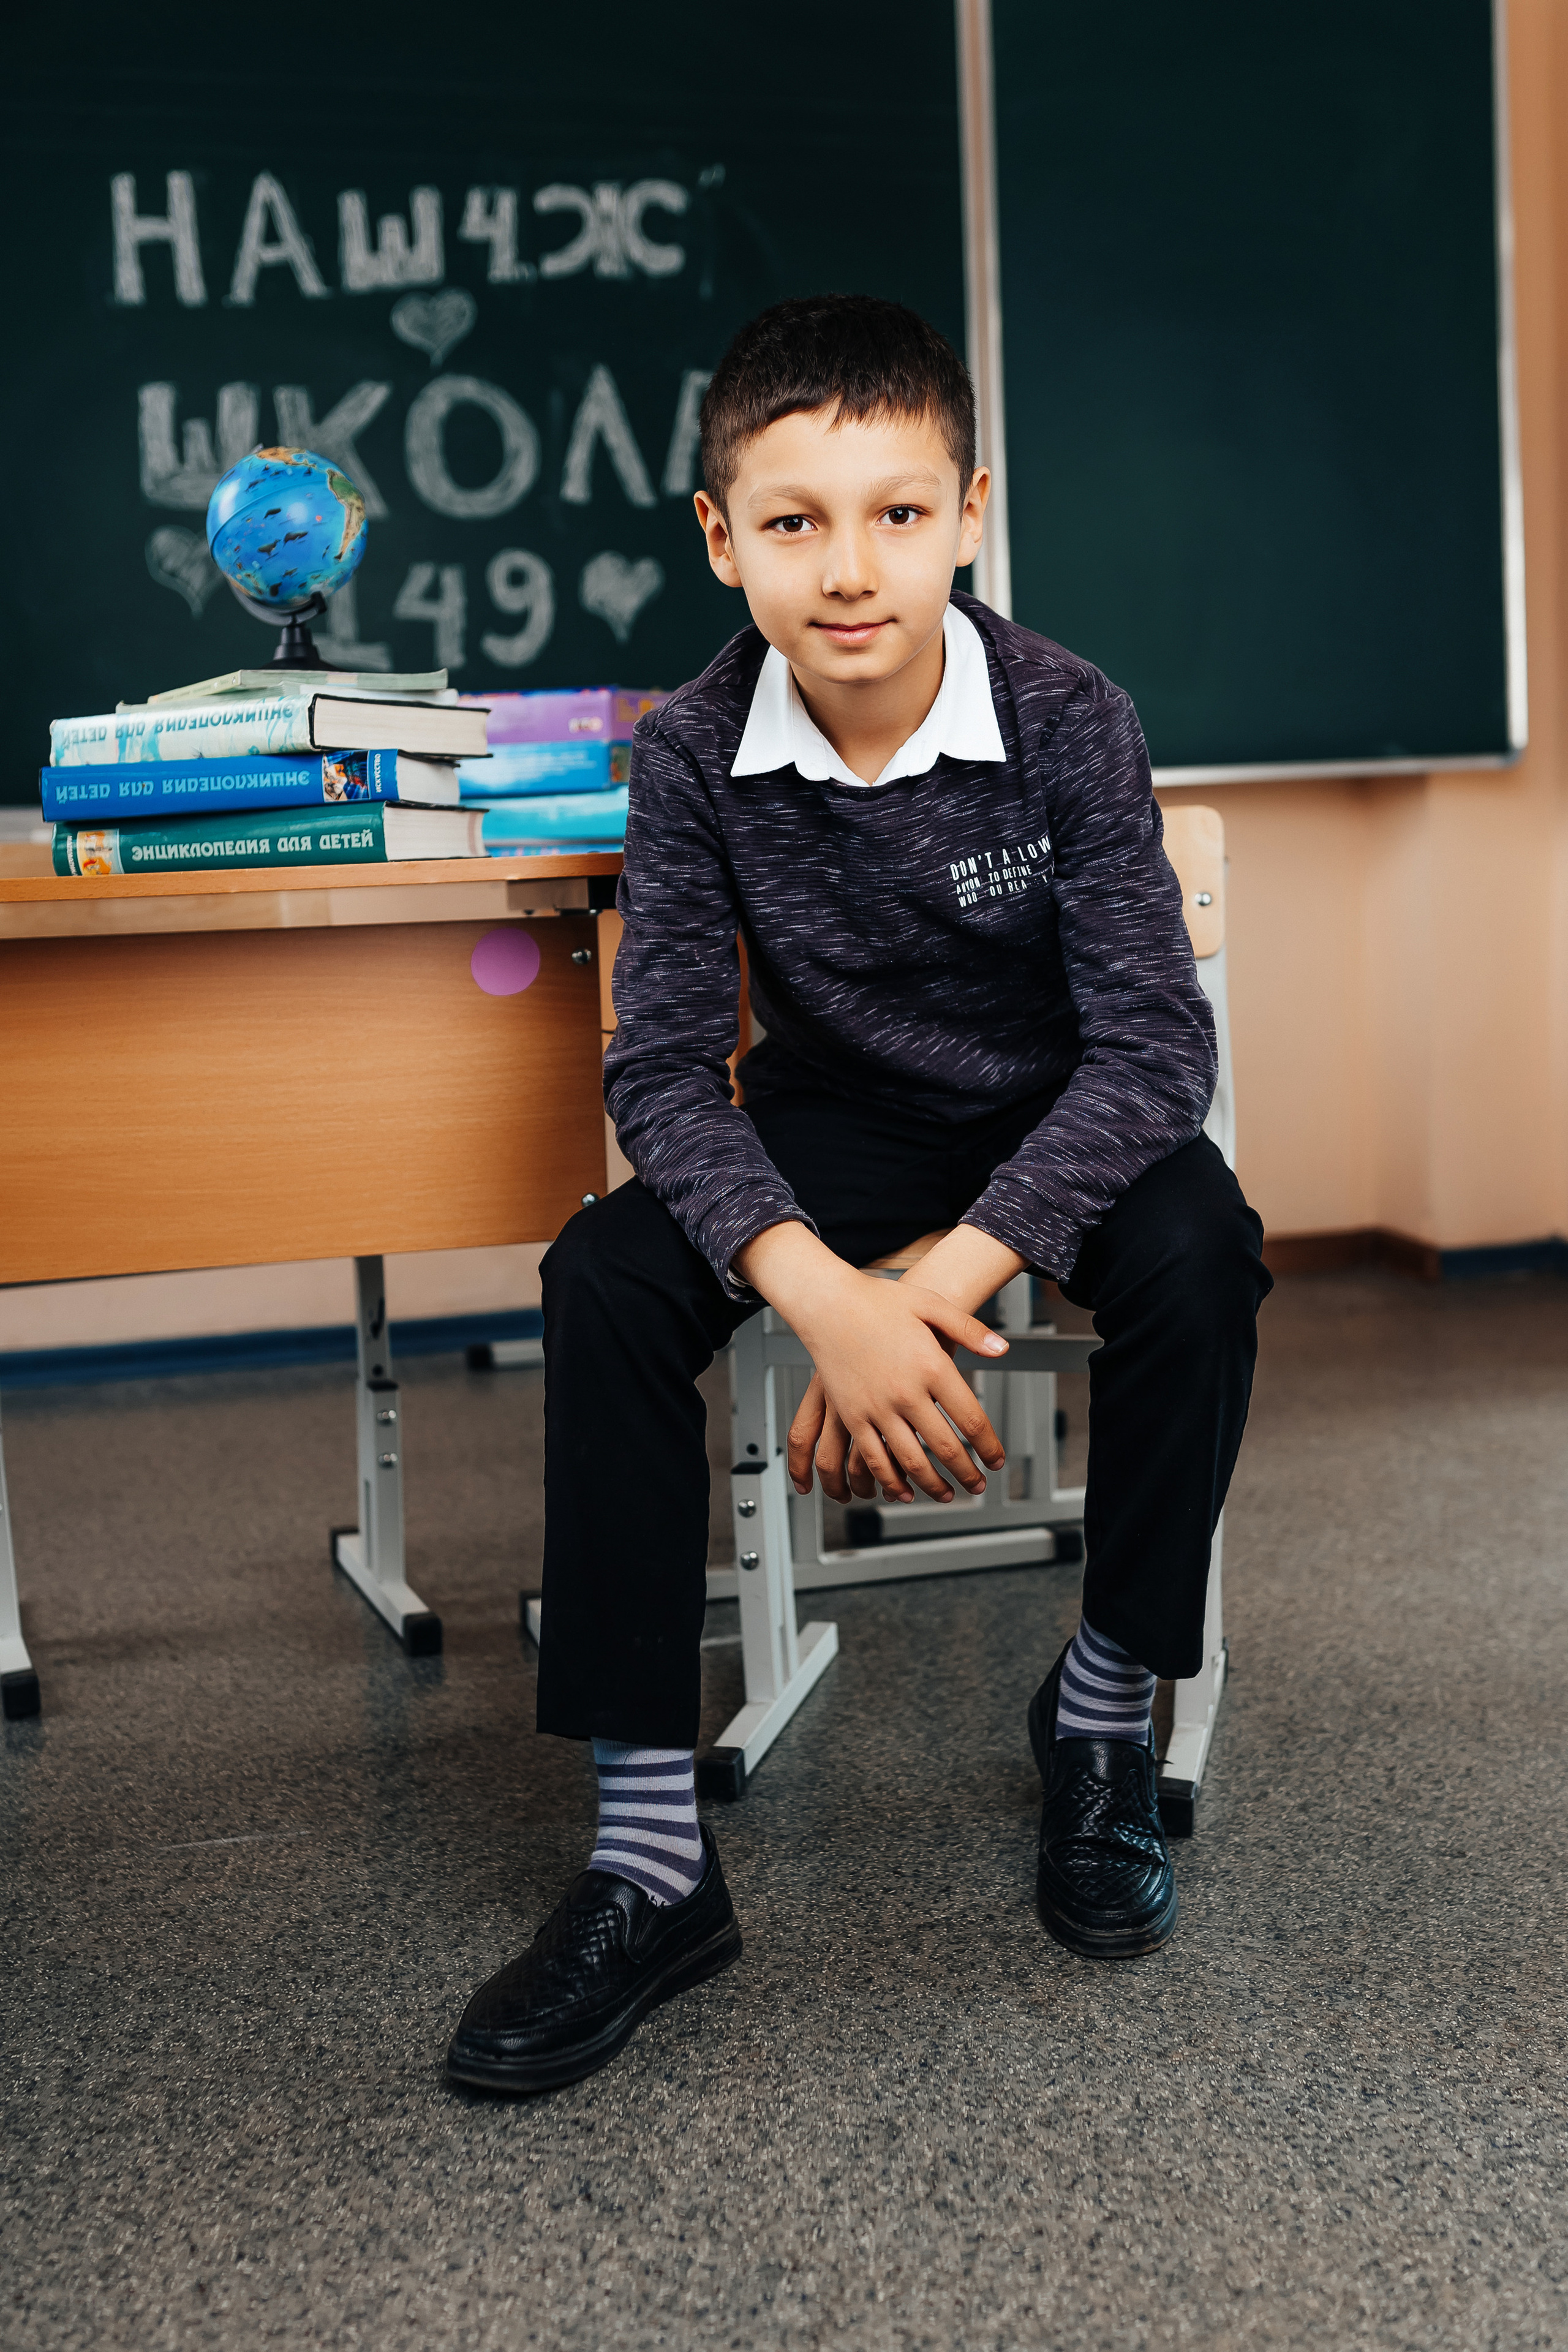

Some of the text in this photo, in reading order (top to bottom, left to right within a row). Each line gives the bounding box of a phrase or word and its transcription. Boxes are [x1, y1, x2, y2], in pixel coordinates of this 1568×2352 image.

[110, 170, 445, 306] НАШ
[115, 721, 145, 738] ДЛЯ
[154, 704, 293, 733] ЭНЦИКЛОПЕДИЯ
[55, 770, 311, 804] ЭНЦИКЛОПЕДИЯ ДЛЯ ДЕТЕЙ
[131, 829, 374, 861] ЭНЦИКЛОПЕДИЯ ДЛЯ ДЕТЕЙ
[949, 851, 992, 881] DON'T
[988, 870, 1000, 883] TO
[1002, 864, 1033, 880] DEFINE
